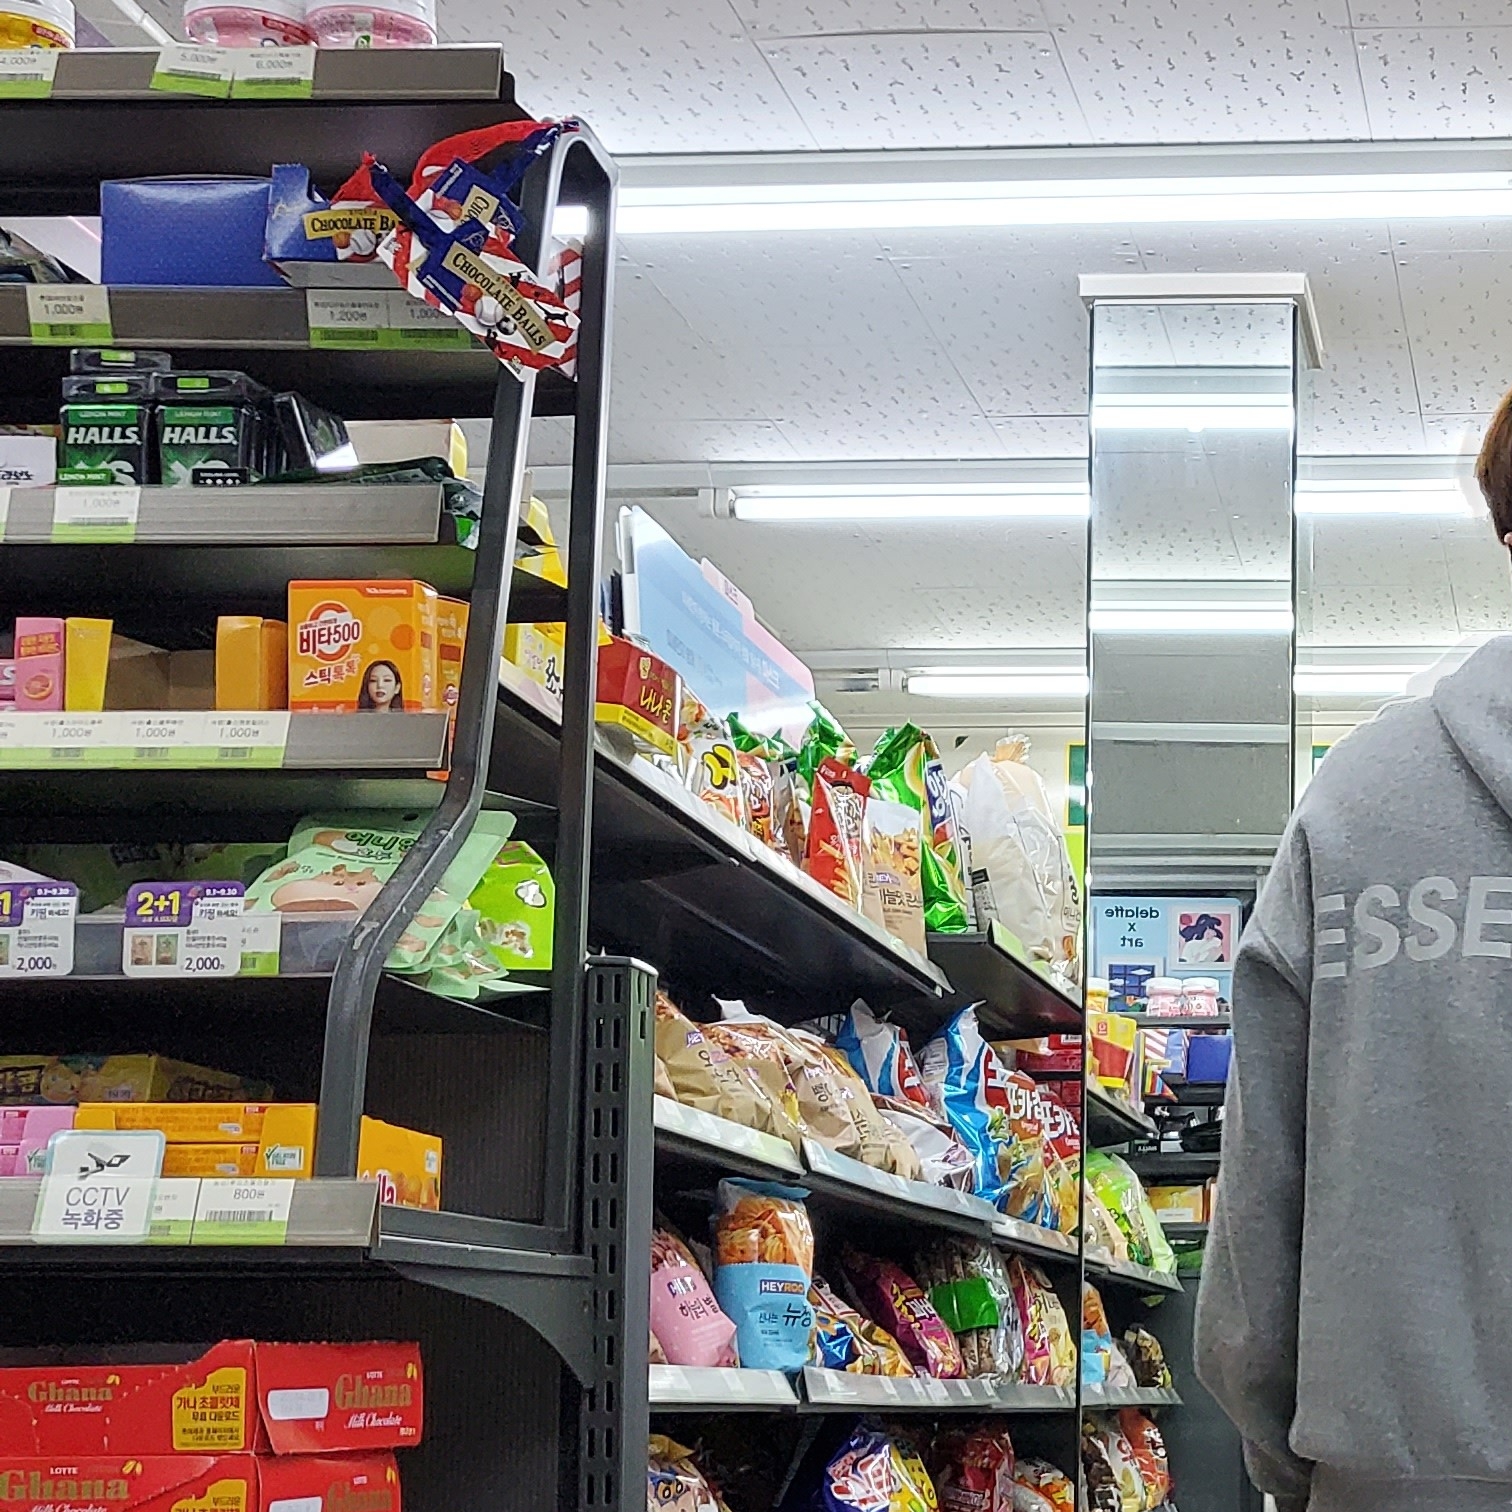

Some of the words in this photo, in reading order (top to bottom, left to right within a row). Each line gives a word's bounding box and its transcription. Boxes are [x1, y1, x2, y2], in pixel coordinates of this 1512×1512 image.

[311, 214, 377, 232] CHOCOLATE
[452, 252, 514, 314] CHOCOLATE
[510, 307, 546, 348] BALLS
[66, 426, 142, 446] HALLS
[162, 426, 239, 446] HALLS
[299, 620, 361, 657] 비타500
[137, 889, 182, 916] 2+1
[65, 1187, 130, 1208] CCTV
[233, 1188, 267, 1201] 800원
[61, 1208, 126, 1231] 녹화중
[760, 1281, 805, 1294] HEYROO
[28, 1381, 114, 1402] Ghana
[335, 1374, 413, 1410] Ghana
[64, 1402, 103, 1413] Chocolate
[366, 1410, 403, 1428] Chocolate
[49, 1466, 79, 1475] LOTTE
[0, 1470, 131, 1502] Ghana
